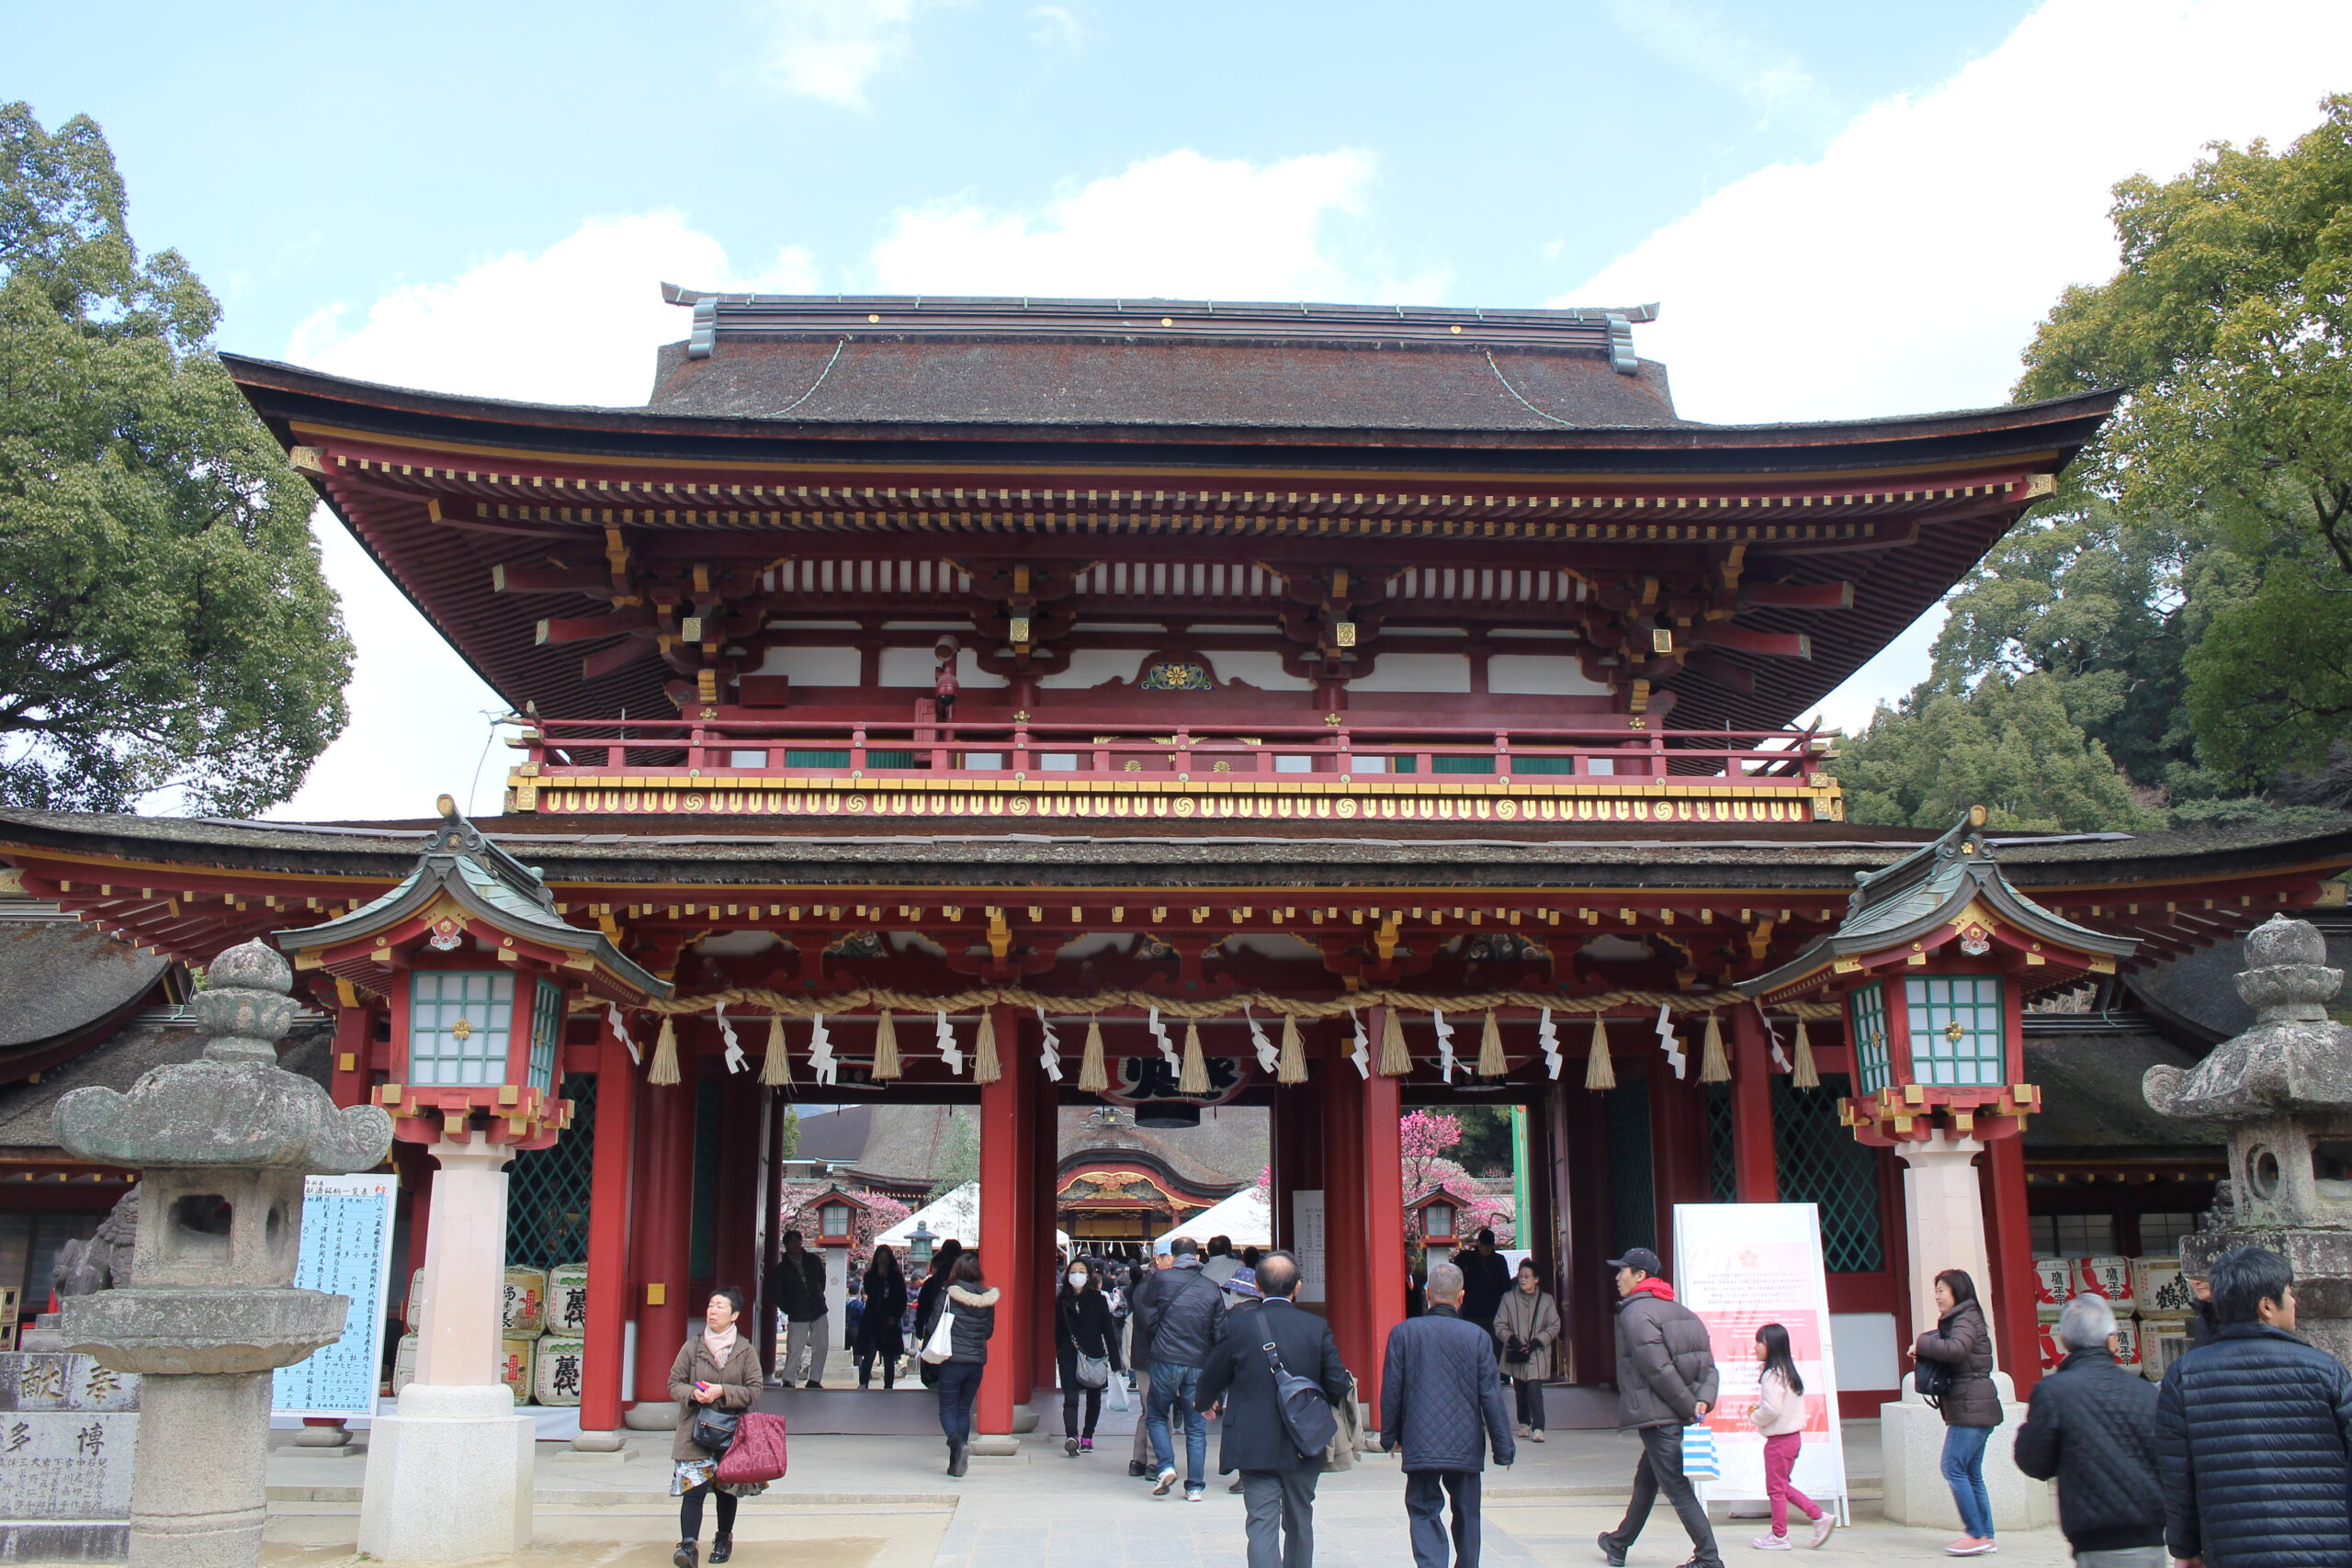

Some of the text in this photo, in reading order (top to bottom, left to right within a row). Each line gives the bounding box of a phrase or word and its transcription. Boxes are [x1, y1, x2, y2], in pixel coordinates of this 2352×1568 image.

[2052, 1271, 2065, 1305] 鷹正宗
[2106, 1267, 2121, 1302] 鷹正宗
[2118, 1331, 2132, 1366] 鷹正宗
[322, 1385, 368, 1393] キッコーマン
[553, 1354, 581, 1397] 萬代
